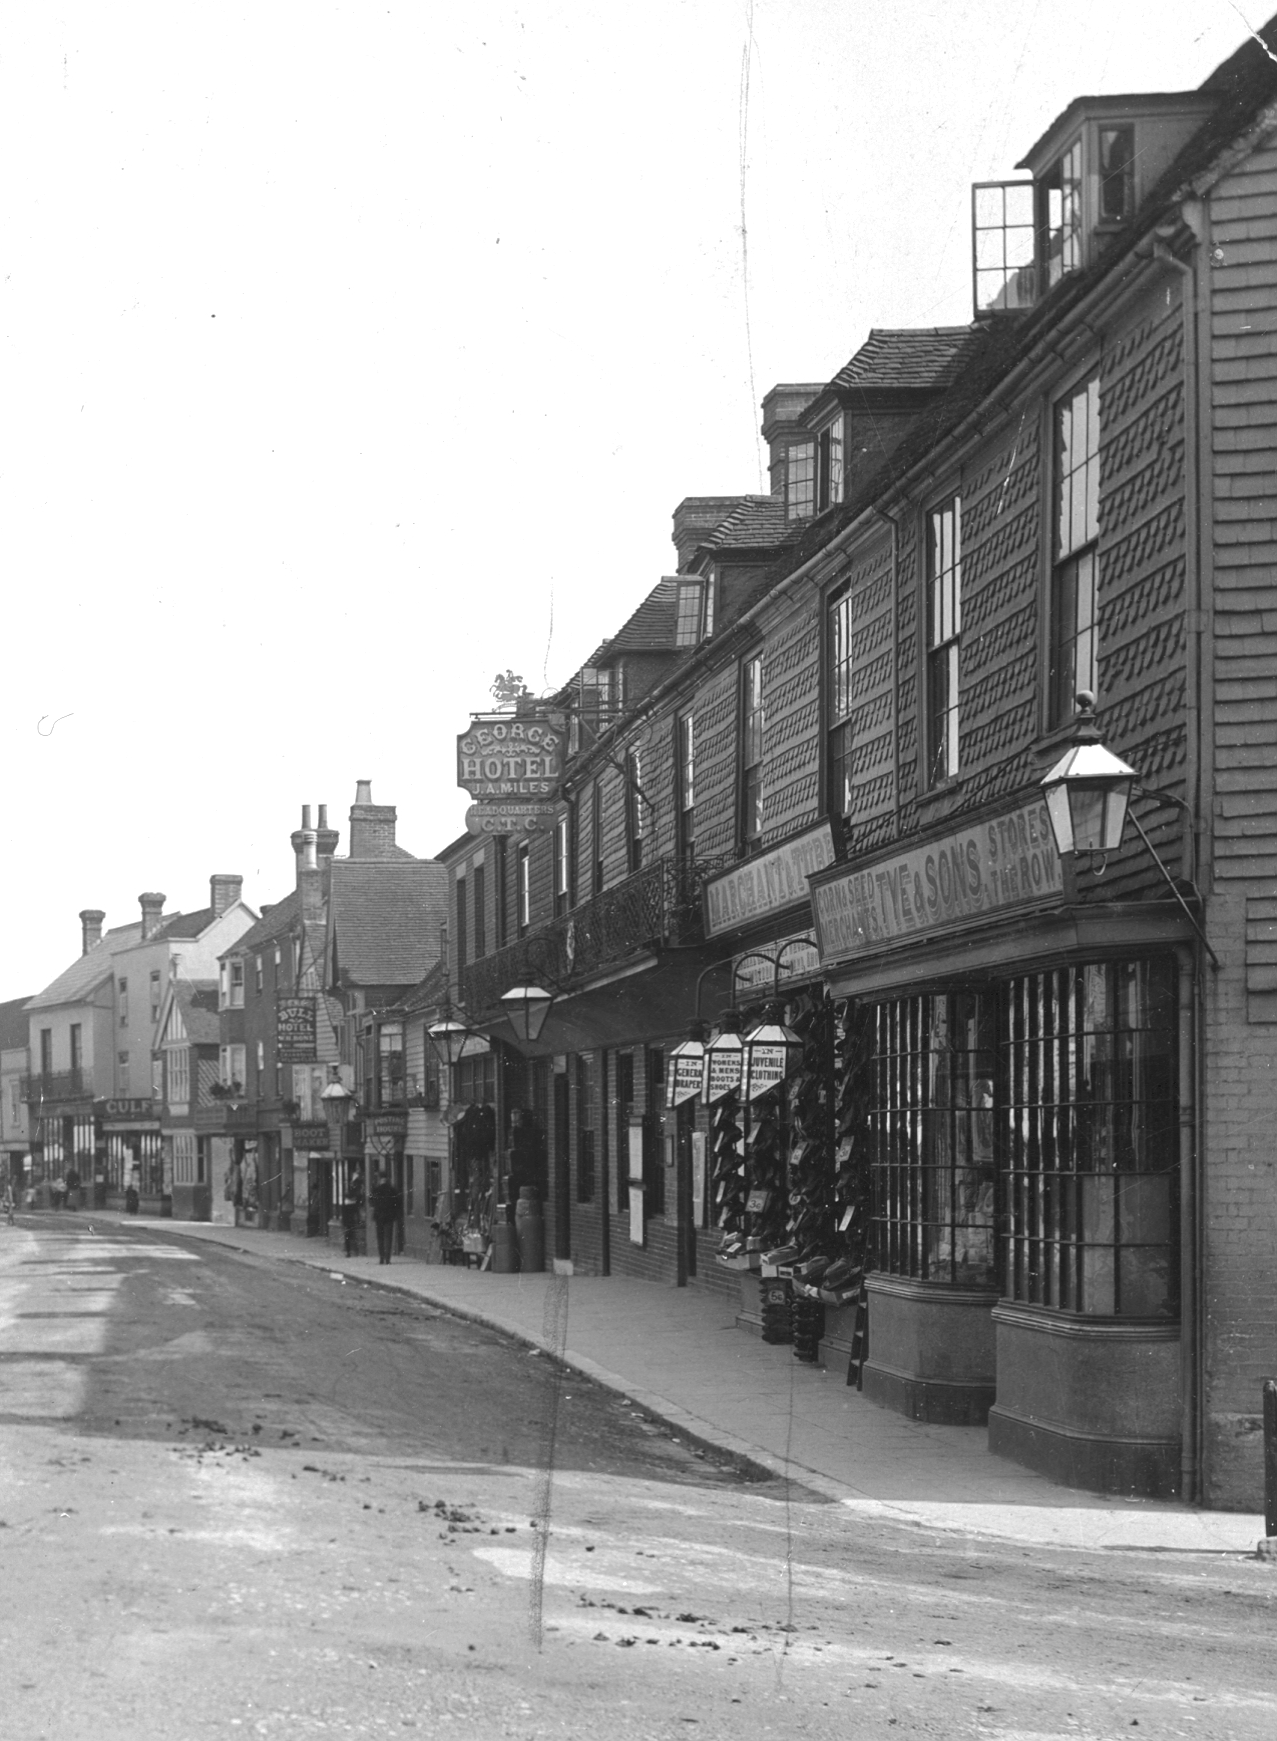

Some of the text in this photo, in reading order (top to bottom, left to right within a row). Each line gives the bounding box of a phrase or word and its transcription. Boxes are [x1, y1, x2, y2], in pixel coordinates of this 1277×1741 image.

[461, 723, 559, 755] GEORGE
[462, 757, 559, 779] HOTEL
[469, 804, 555, 816] HEADQUARTERS
[988, 805, 1049, 857] STORES
[991, 865, 1019, 898] THE
[709, 855, 786, 927] MARCHANT
[817, 872, 874, 916] CORN & SEED
[875, 863, 913, 926] TYE
[914, 871, 924, 915] &
[278, 1007, 314, 1021] BULL
[278, 1023, 314, 1032] HOTEL
[751, 1057, 784, 1068] JUVENILE
[711, 1075, 734, 1083] BOOTS
[751, 1070, 783, 1080] CLOTHING
[293, 1128, 326, 1138] BOOT
[293, 1138, 328, 1147] MAKER
